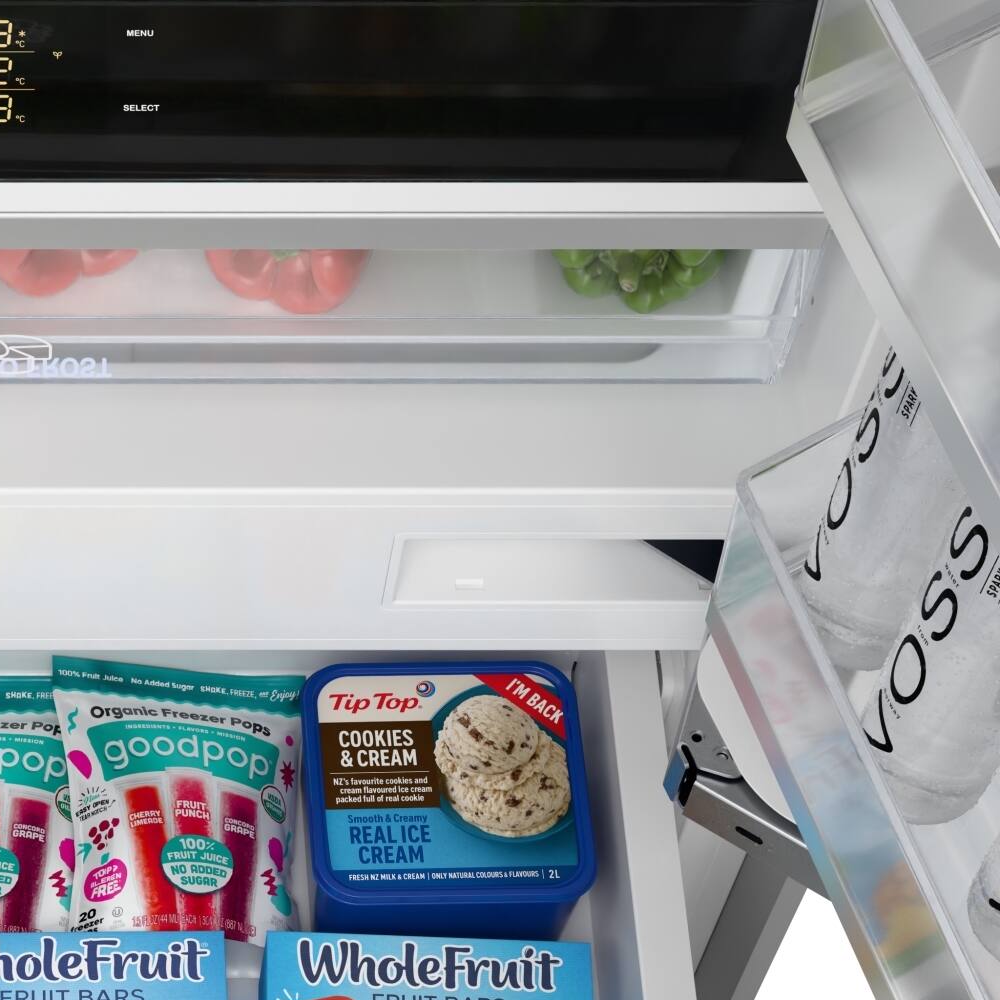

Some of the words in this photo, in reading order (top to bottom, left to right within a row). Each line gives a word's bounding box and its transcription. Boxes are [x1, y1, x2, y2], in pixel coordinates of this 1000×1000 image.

[126, 29, 154, 37] MENU
[123, 104, 160, 112] SELECT
[863, 506, 989, 754] VOSS
[57, 669, 81, 678] 100%
[82, 672, 101, 681] Fruit
[102, 674, 124, 683] Juice
[131, 677, 142, 685] No
[144, 679, 170, 688] Added
[172, 682, 195, 692] Sugar
[270, 689, 300, 702] Enjoy!
[329, 693, 371, 714] Tip
[373, 692, 419, 713] Top
[505, 678, 529, 700] I'M
[527, 692, 564, 724] BACK
[90, 705, 158, 719] Organic
[162, 708, 227, 725] Freezer
[230, 717, 272, 737] Pops
[338, 729, 414, 749] COOKIES
[104, 735, 270, 780] goodpop
[340, 751, 354, 768] &
[356, 749, 418, 768] CREAM
[333, 777, 349, 786] NZ's
[350, 776, 384, 786] favourite
[385, 776, 412, 785] cookies
[413, 776, 428, 785] and
[340, 787, 362, 795] cream
[363, 786, 397, 795] flavoured
[398, 786, 409, 794] ice
[410, 786, 433, 794] cream
[176, 800, 207, 810] FRUIT
[335, 795, 360, 805] packed
[361, 794, 375, 804] full
[376, 794, 384, 803] of
[385, 794, 400, 803] real
[400, 794, 425, 803] cookie
[129, 810, 161, 821] CHERRY
[130, 815, 164, 828] LIMEADE
[174, 809, 210, 820] PUNCH
[347, 814, 385, 824] Smooth
[386, 814, 393, 823] &
[393, 813, 428, 825] Creamy
[13, 823, 46, 835] CONCORD
[224, 816, 255, 832] CONCORD
[12, 829, 46, 843] GRAPE
[224, 823, 256, 841] GRAPE
[350, 826, 397, 845] REAL
[401, 824, 431, 844] ICE
[179, 837, 215, 850] 100%
[167, 850, 197, 861] FRUIT
[200, 852, 230, 865] JUICE
[359, 846, 424, 865] CREAM
[170, 865, 186, 876] NO
[190, 865, 227, 878] ADDED
[349, 874, 369, 882] FRESH
[370, 873, 380, 881] NZ
[380, 873, 396, 881] MILK
[403, 872, 426, 880] CREAM
[431, 872, 447, 880] ONLY
[448, 871, 475, 880] NATURAL
[476, 871, 503, 879] COLOURS
[509, 870, 539, 879] FLAVOURS
[549, 869, 560, 879] 2L
[180, 875, 218, 887] SUGAR
[90, 880, 121, 900] FREE
[79, 908, 97, 924] 20
[70, 917, 104, 932] freezer
[298, 939, 562, 991] WholeFruit
